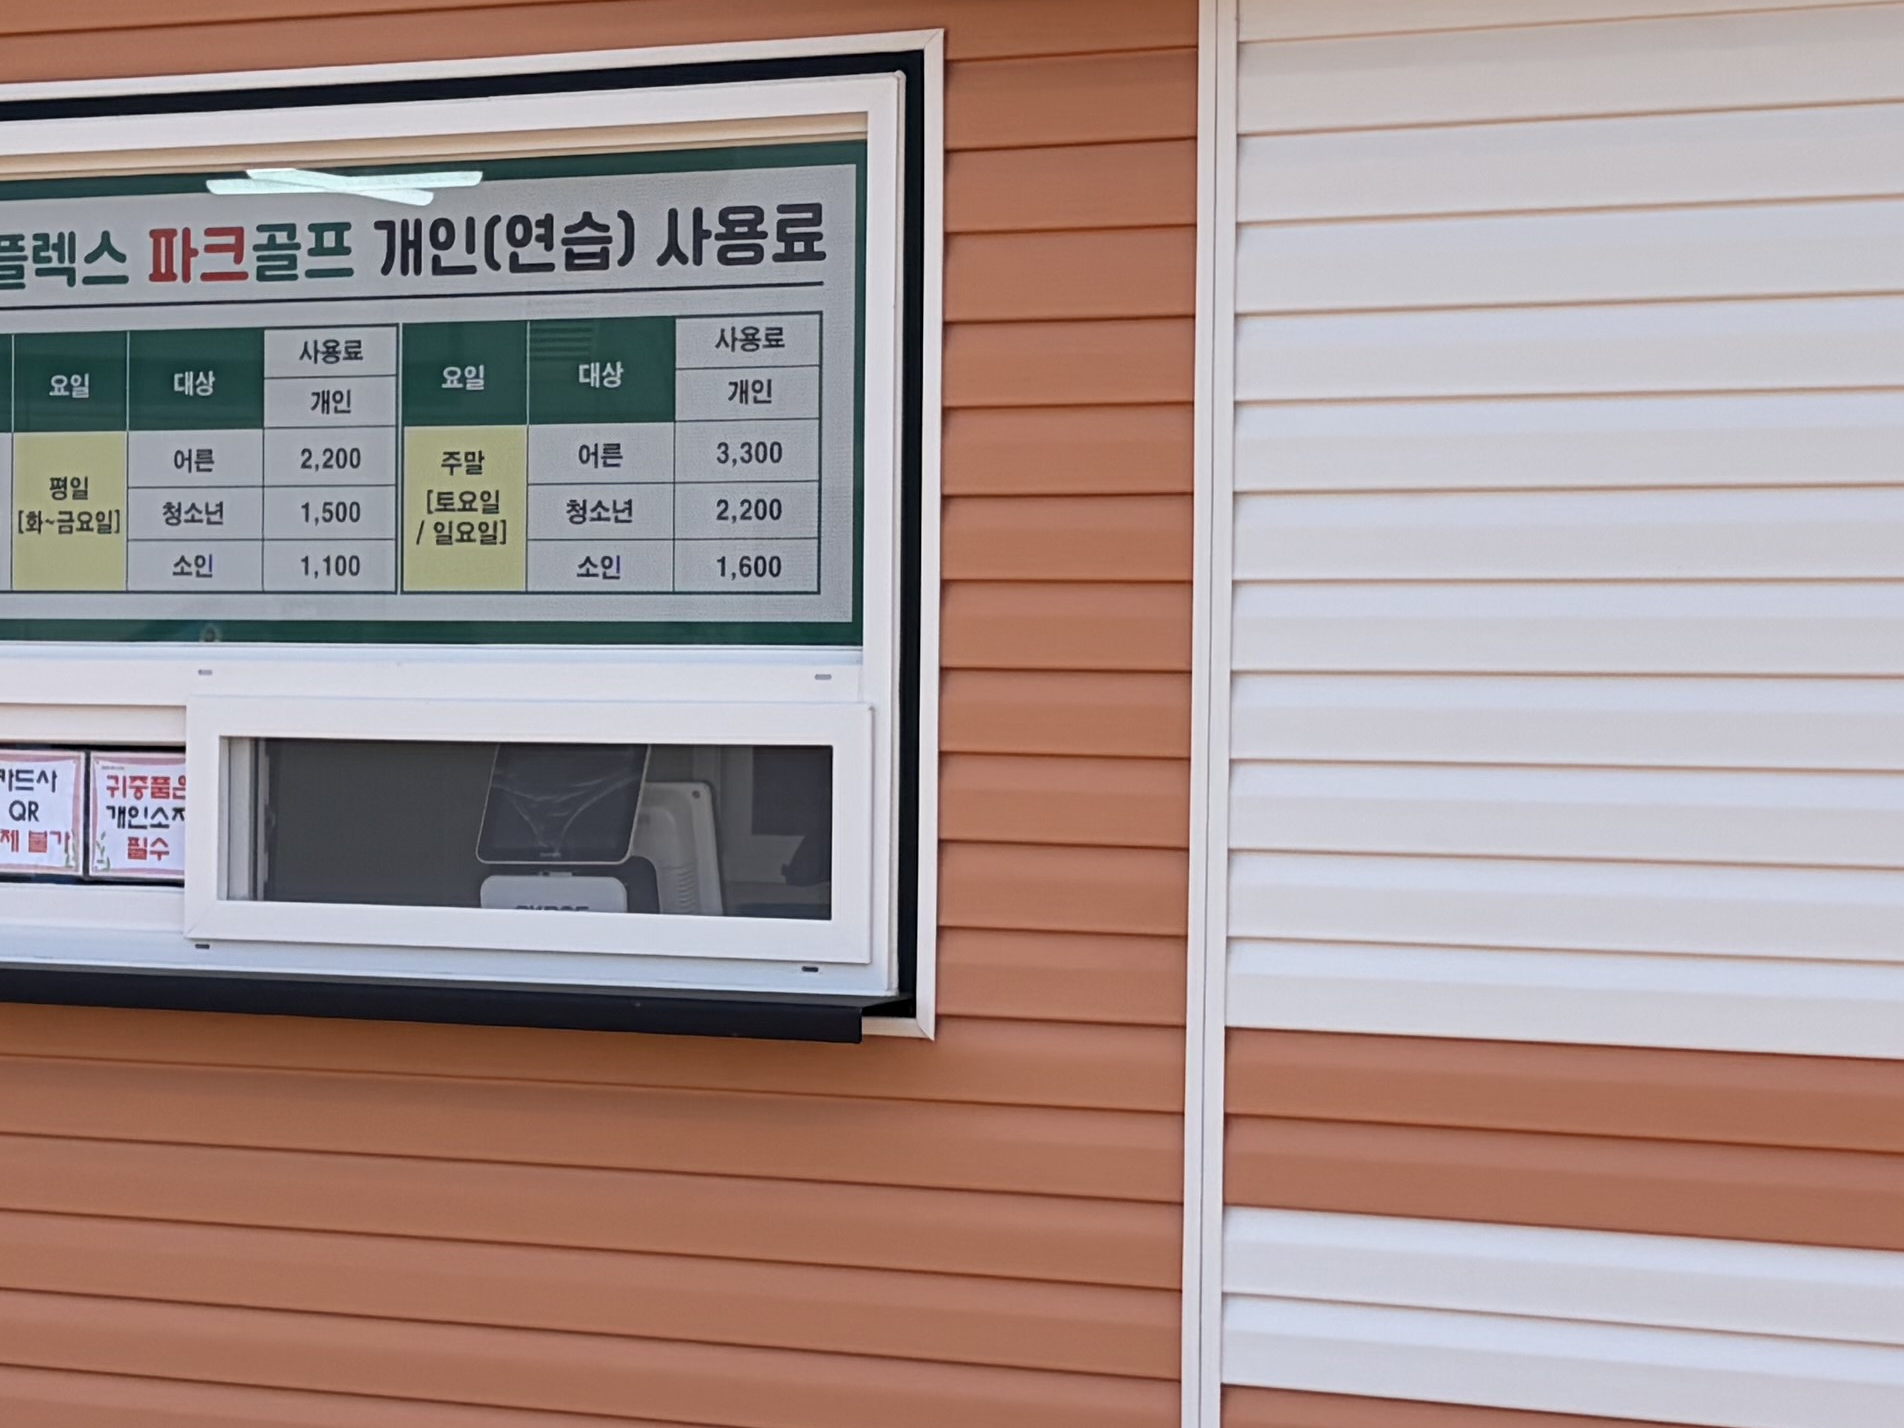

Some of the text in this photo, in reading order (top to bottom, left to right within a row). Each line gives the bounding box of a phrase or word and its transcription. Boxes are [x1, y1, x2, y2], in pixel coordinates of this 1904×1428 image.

[148, 220, 354, 283] 파크골프
[374, 209, 635, 278] 개인(연습)
[657, 202, 827, 267] 사용료
[716, 325, 785, 352] 사용료
[299, 339, 364, 364] 사용료
[49, 373, 90, 398] 요일
[174, 371, 215, 396] 대상
[441, 365, 485, 390] 요일
[578, 361, 624, 388] 대상
[311, 390, 352, 414] 개인
[728, 379, 773, 405] 개인
[174, 449, 215, 472] 어른
[300, 448, 361, 472] 2,200
[441, 450, 485, 476] 주말
[578, 442, 623, 468] 어른
[716, 441, 782, 467] 3,300
[49, 476, 89, 501] 평일
[162, 501, 225, 526] 청소년
[301, 501, 361, 525] 1,500
[427, 490, 500, 515] [토요일
[566, 499, 633, 525] 청소년
[716, 499, 782, 524] 2,200
[18, 509, 121, 535] [화~금요일]
[433, 520, 507, 545] 일요일]
[172, 555, 213, 578] 소인
[301, 555, 360, 579] 1,100
[576, 555, 621, 580] 소인
[716, 556, 781, 580] 1,600
[9, 800, 39, 822] QR
[28, 831, 70, 853] 불가
[127, 837, 169, 861] 필수
